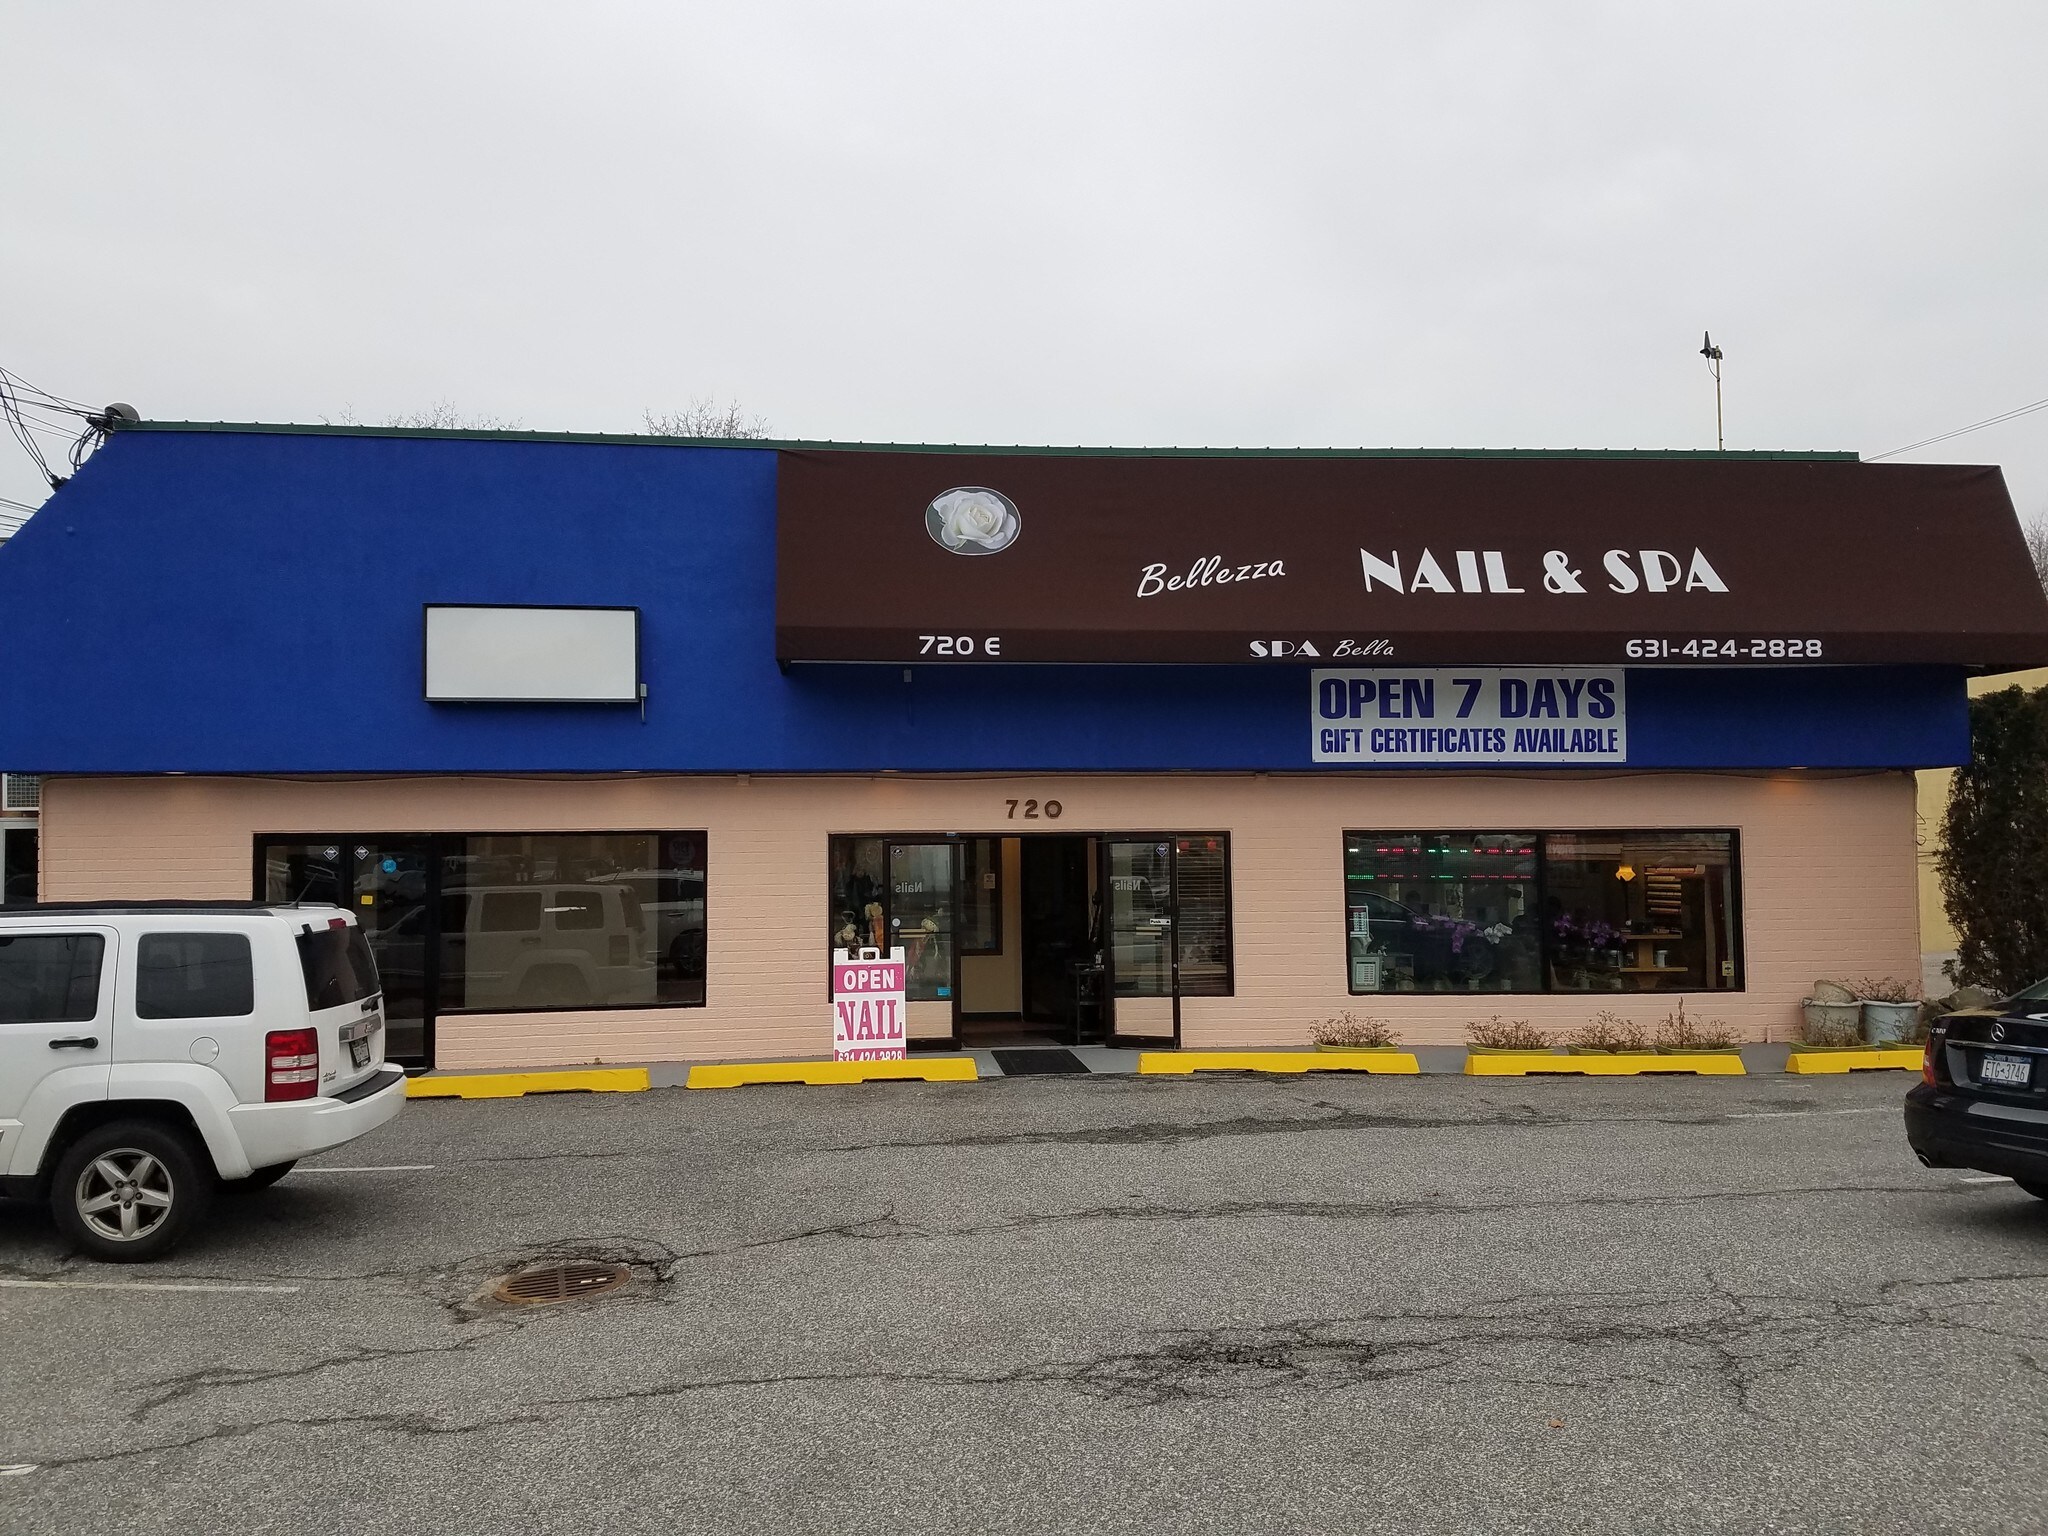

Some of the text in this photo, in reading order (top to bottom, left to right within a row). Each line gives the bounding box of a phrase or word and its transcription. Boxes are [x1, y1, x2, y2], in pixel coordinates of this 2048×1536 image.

[1136, 547, 1730, 598] Bellezza NAIL & SPA
[918, 635, 1001, 656] 720 E
[1248, 638, 1394, 658] SPA Bella
[1625, 639, 1823, 658] 631-424-2828
[1319, 677, 1616, 720] OPEN 7 DAYS
[1320, 727, 1618, 754] GIFT CERTIFICATES AVAILABLE
[1005, 800, 1063, 819] 720
[843, 969, 895, 990] OPEN
[837, 999, 903, 1041] NAIL
[2004, 1063, 2027, 1081] 3746
